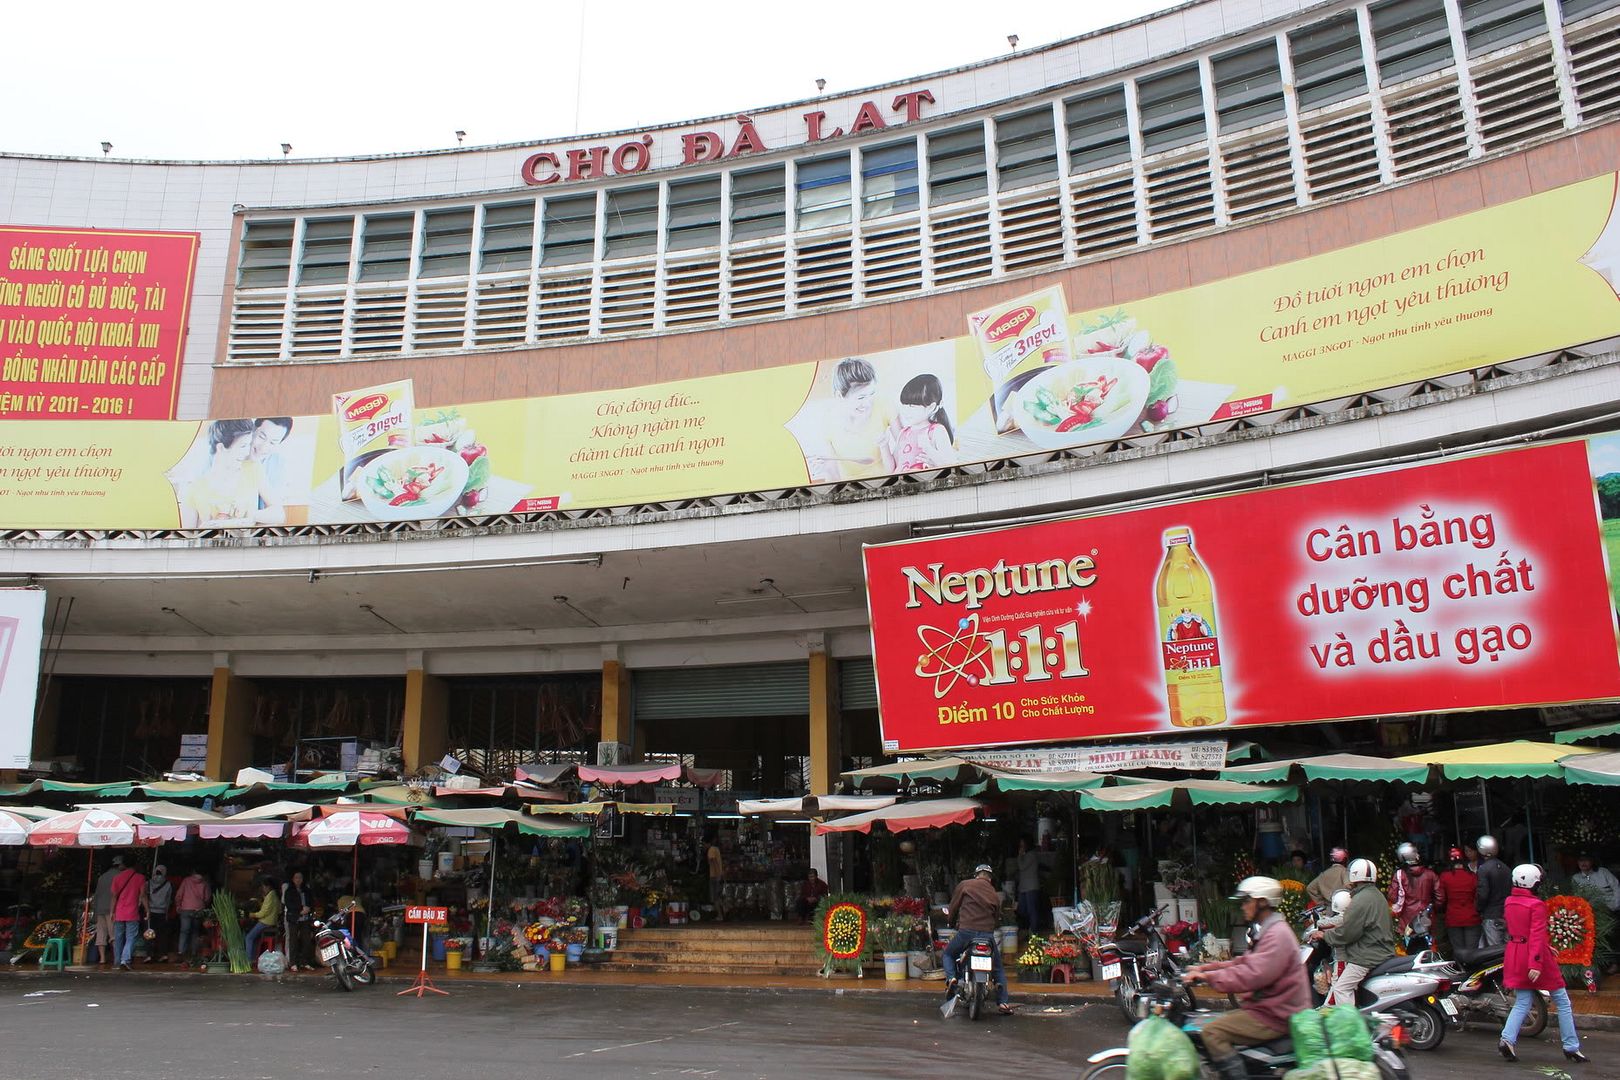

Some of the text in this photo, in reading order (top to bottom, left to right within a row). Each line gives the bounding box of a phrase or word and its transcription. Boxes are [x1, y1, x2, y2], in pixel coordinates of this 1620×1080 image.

[681, 114, 768, 165] ĐÀ
[9, 241, 147, 279] SÁNG SUỐT LỰA CHỌN
[1273, 290, 1304, 312] Đồ
[1349, 272, 1396, 298] ngon
[1400, 263, 1430, 281] em
[1436, 248, 1486, 268] chọn
[24, 278, 65, 308] NGƯỜI
[66, 280, 84, 308] CÓ
[88, 278, 107, 310] ĐỦ
[110, 281, 139, 313] ĐỨC,
[144, 282, 166, 310] TÀI
[1259, 270, 1510, 343] Canh em ngọt yêu thương
[8, 314, 36, 344] VÀO
[37, 314, 73, 348] QUỐC
[74, 317, 99, 351] HỘI
[100, 318, 134, 348] KHOÁ
[138, 323, 160, 348] XIII
[1282, 347, 1316, 362] MAGGI
[2, 349, 166, 386] ĐỒNG NHÂN DÂN CÁC CẤP
[26, 391, 46, 412] KỲ
[49, 396, 79, 412] 2011
[92, 397, 124, 414] 2016
[596, 401, 625, 416] Chợ
[684, 416, 706, 430] mẹ
[18, 447, 52, 461] ngon
[56, 448, 76, 457] em
[80, 444, 112, 460] chọn
[613, 443, 646, 460] chút
[648, 436, 685, 456] canh
[689, 436, 726, 454] ngon
[12, 466, 41, 482] ngọt
[45, 466, 70, 482] yêu
[570, 472, 597, 480] MAGGI
[1306, 503, 1496, 562] Cân bằng
[902, 555, 1098, 609] Neptune
[1296, 549, 1535, 617] dưỡng chất
[984, 620, 1090, 685] 1:1:1
[1166, 642, 1214, 654] Neptune
[1310, 619, 1532, 670] và dầu gạo
[1020, 692, 1086, 706] Cho Sức Khỏe
[938, 701, 1016, 724] Điểm 10
[1022, 704, 1094, 718] Cho Chất Lượng
[1016, 759, 1042, 768] LAN
[1088, 750, 1182, 764] MINH TRANG
[408, 906, 421, 919] CẤM
[437, 910, 446, 920] XE
